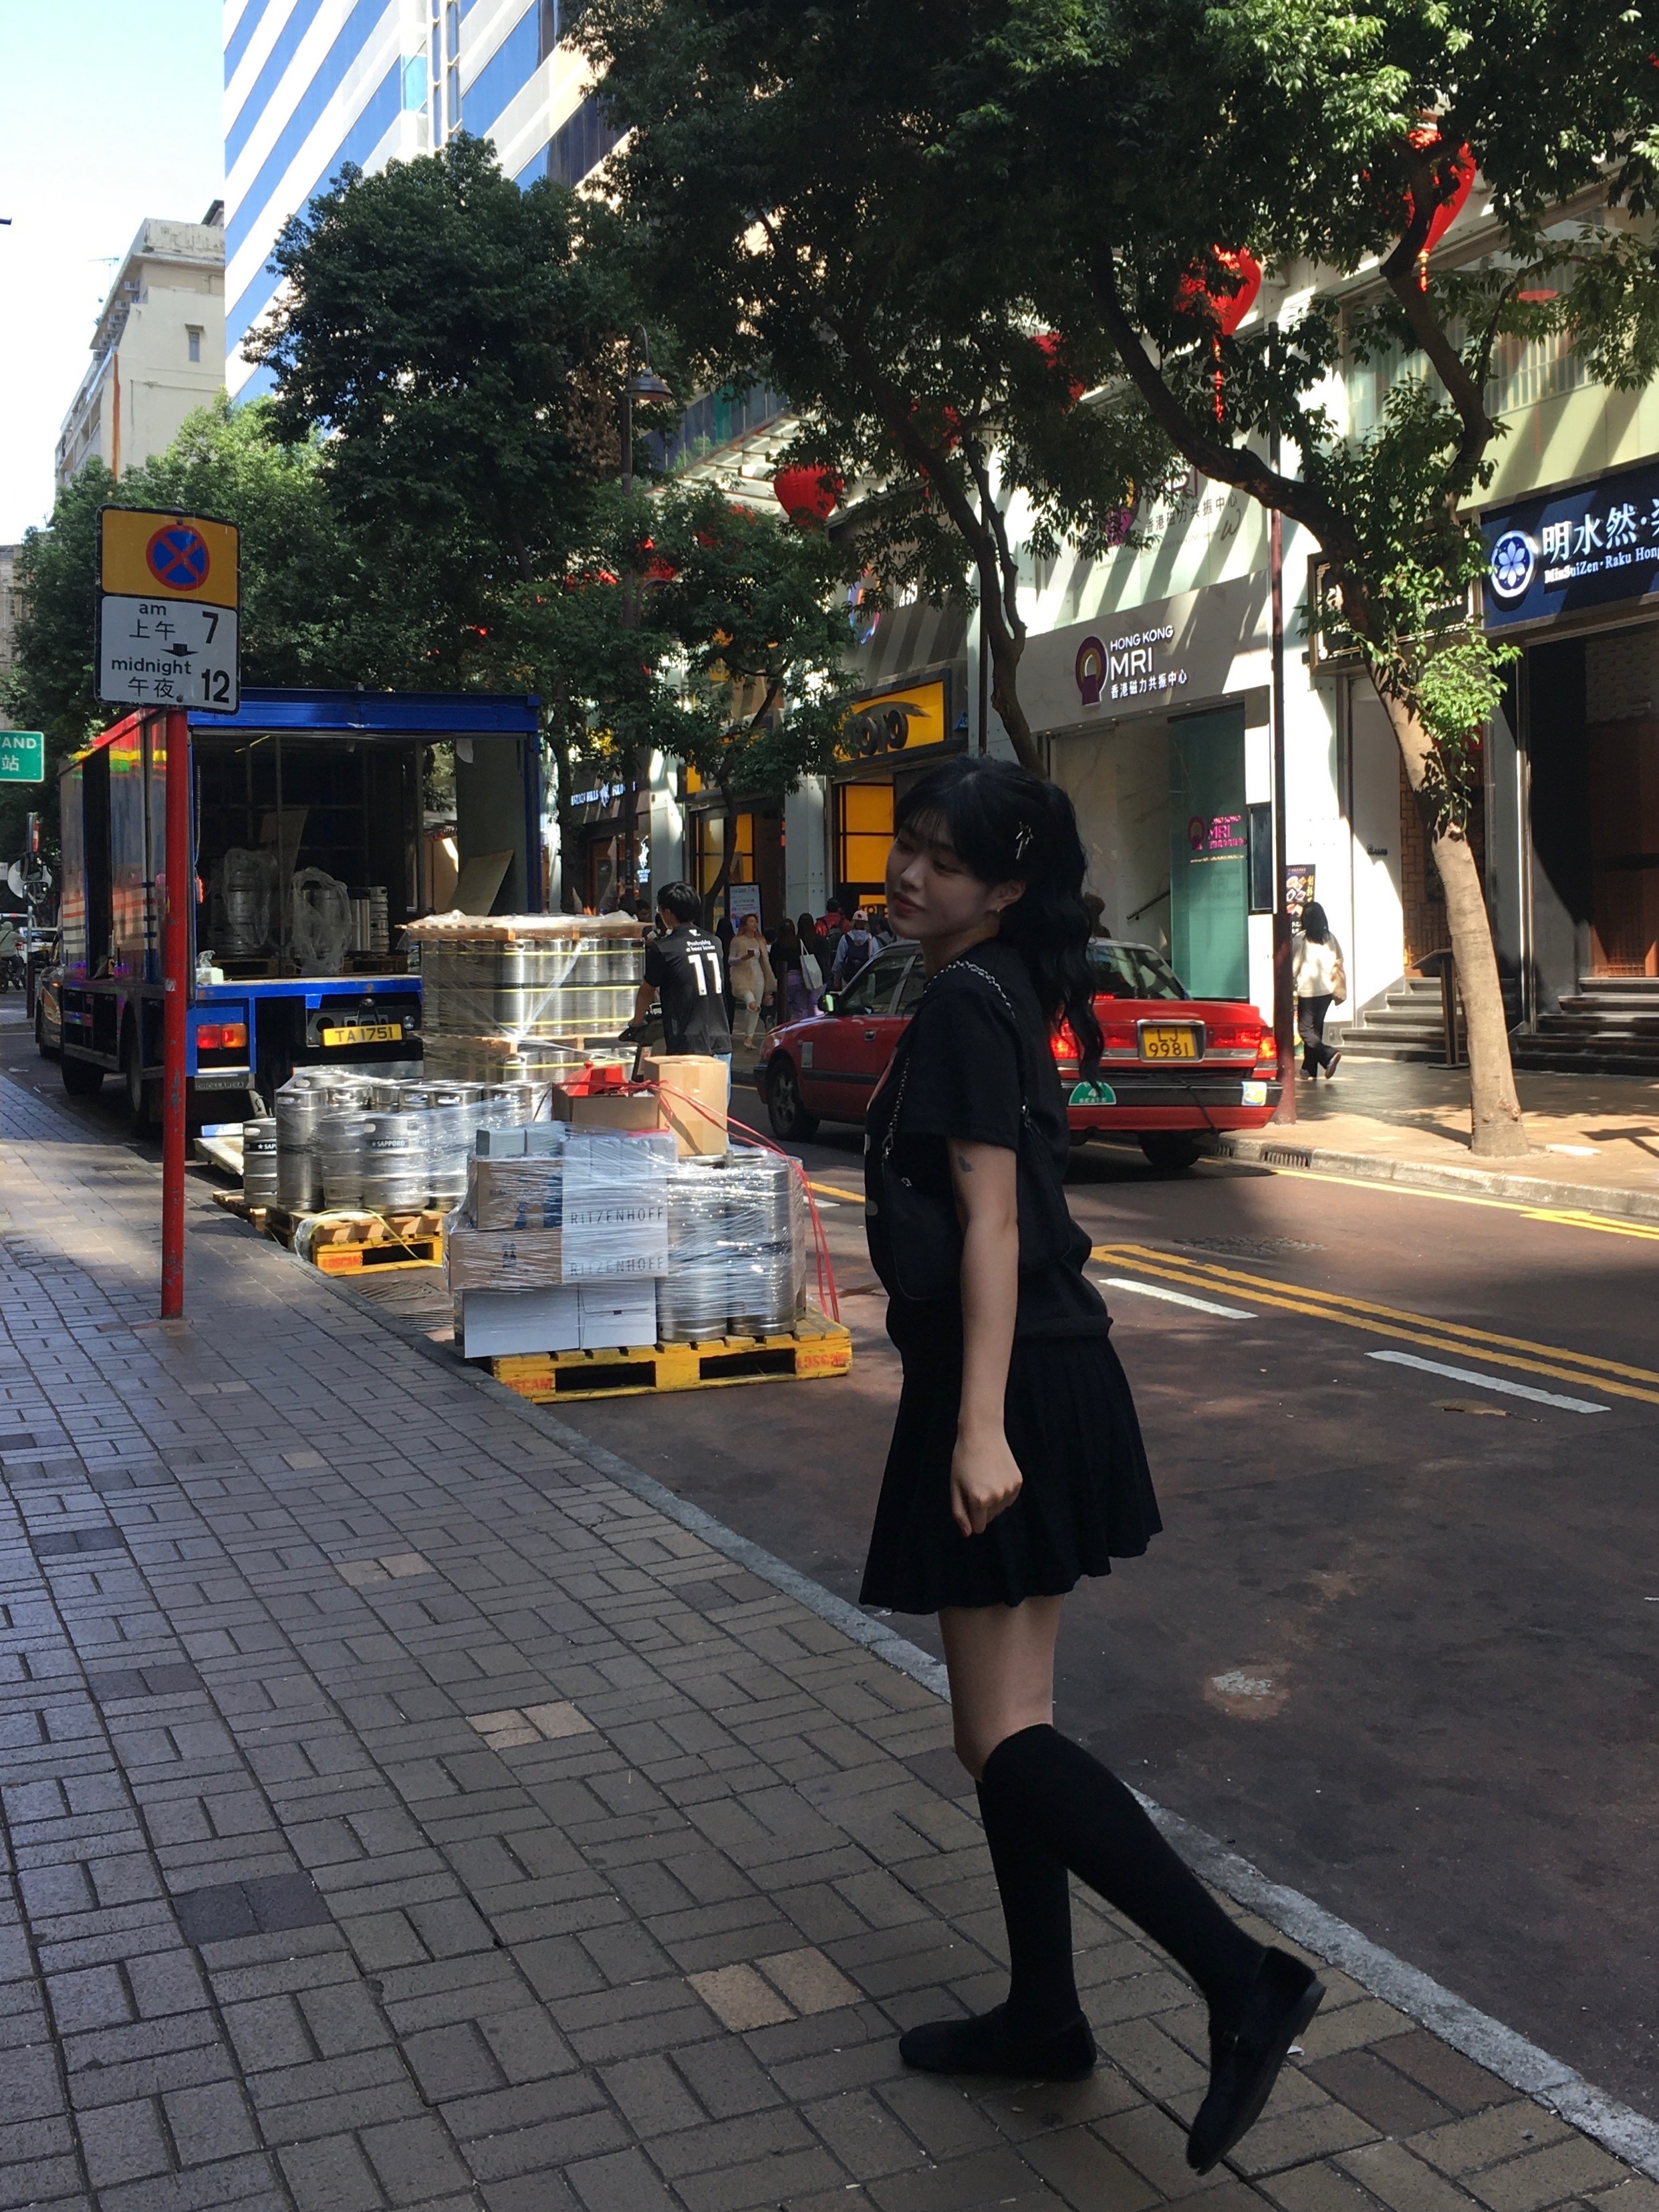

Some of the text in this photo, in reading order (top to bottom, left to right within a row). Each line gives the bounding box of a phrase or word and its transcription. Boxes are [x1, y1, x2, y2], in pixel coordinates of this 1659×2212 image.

[1635, 546, 1659, 562] Hon
[129, 619, 176, 641] 上午
[139, 604, 219, 644] am 7
[1110, 625, 1174, 652] HONG KONG
[1110, 647, 1152, 681] MRI
[112, 657, 229, 703] midnight 12
[128, 677, 174, 699] 午夜
[1111, 668, 1188, 699] 香港磁力共振中心
[0, 737, 36, 749] AND
[1, 754, 19, 772] 站
[1208, 824, 1231, 840] MRI
[688, 953, 722, 996] 11
[335, 1026, 393, 1043] TA 1751
[1157, 1029, 1178, 1043] LJ
[1149, 1042, 1189, 1058] 9981
[570, 1207, 664, 1224] RITZENHOFF
